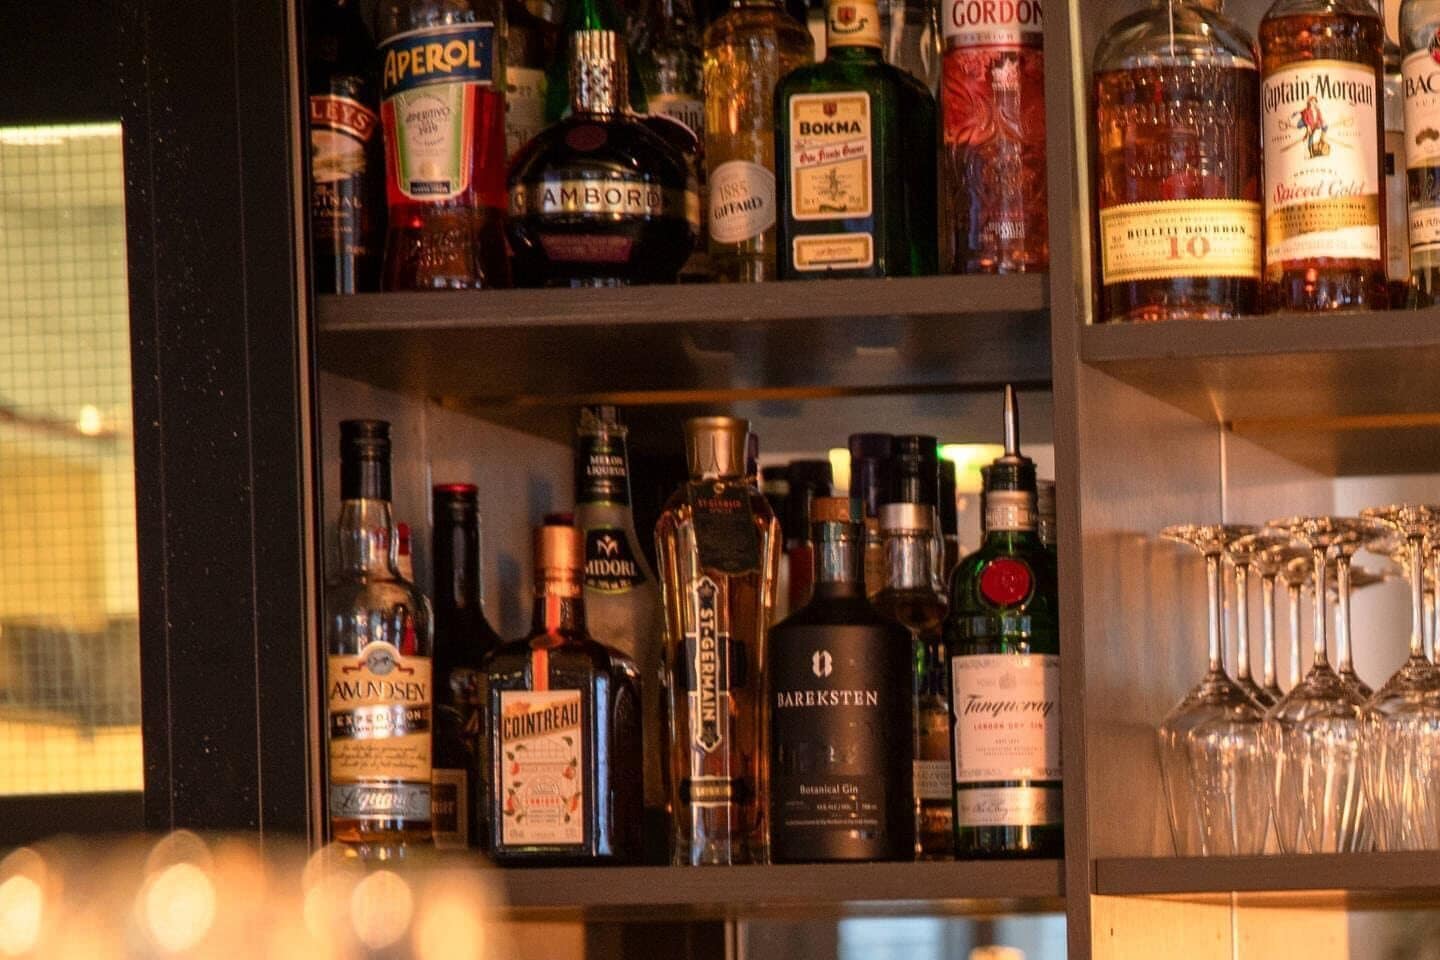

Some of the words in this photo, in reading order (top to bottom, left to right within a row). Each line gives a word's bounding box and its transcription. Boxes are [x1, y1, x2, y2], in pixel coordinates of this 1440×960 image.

[953, 0, 1043, 28] GORDON
[384, 39, 481, 91] APEROL
[1263, 74, 1310, 114] Captain
[1315, 74, 1373, 108] Morgan
[311, 100, 369, 131] LEYS
[799, 120, 862, 137] BOKMA
[543, 187, 662, 207] AMBORD
[1127, 225, 1180, 240] BULLEIT
[1185, 224, 1247, 236] BOURBON
[1166, 234, 1211, 261] 10
[700, 607, 716, 721] ST-GERMAIN
[330, 681, 428, 701] AMUNDSEN
[777, 690, 879, 708] BAREKSTEN
[964, 694, 1055, 718] Tanqueray
[503, 702, 579, 741] COINTREAU
[842, 783, 859, 794] Gin
